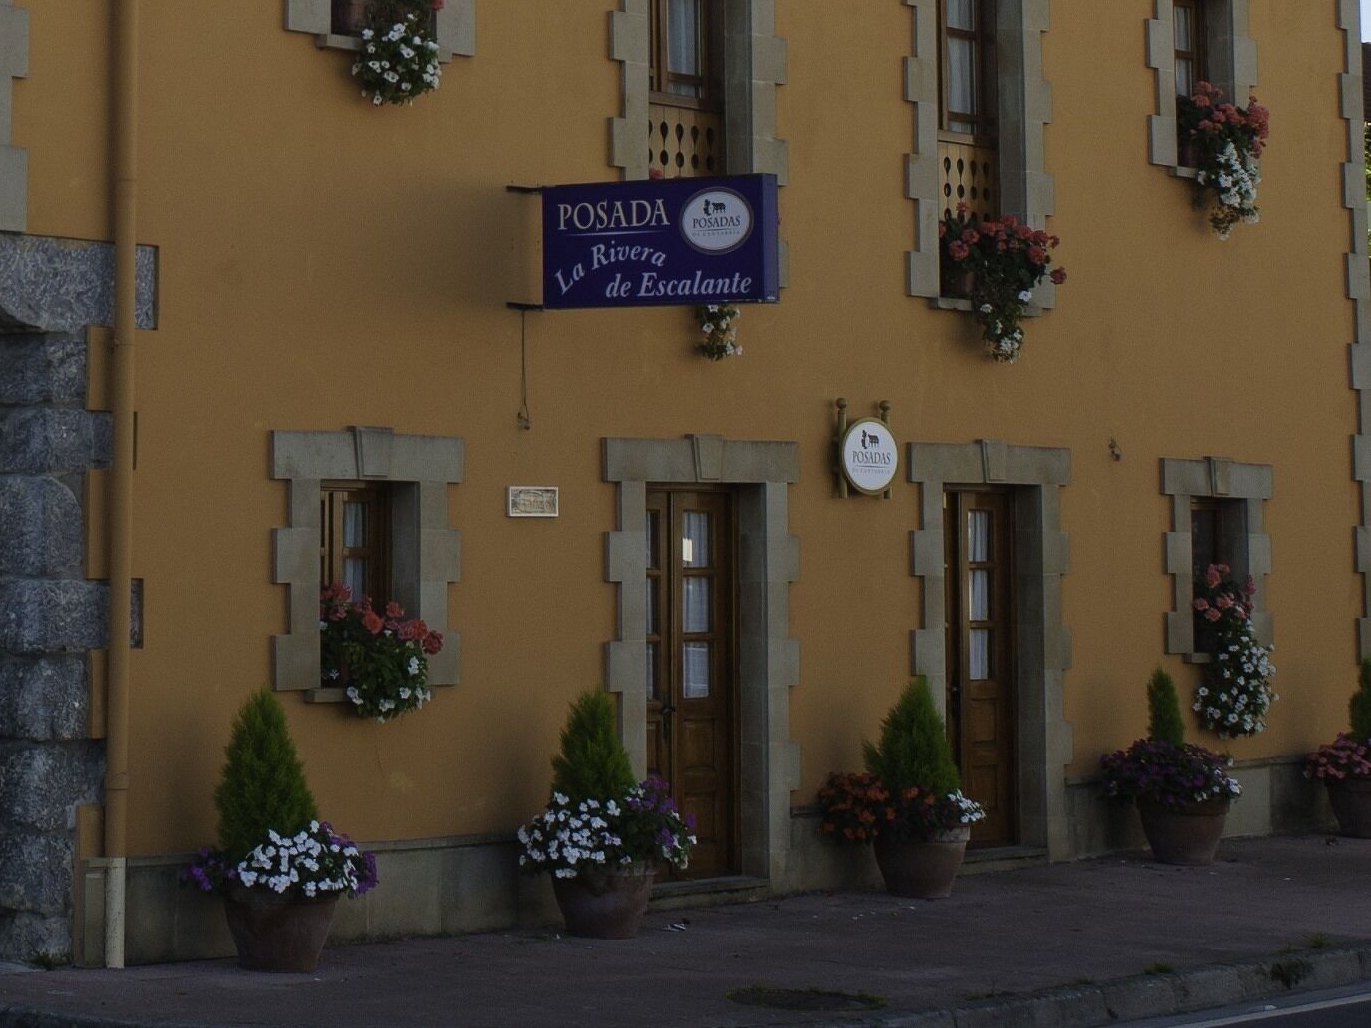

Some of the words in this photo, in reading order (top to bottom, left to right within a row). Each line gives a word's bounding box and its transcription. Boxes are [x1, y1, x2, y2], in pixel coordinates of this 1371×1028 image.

[557, 198, 671, 231] POSADA
[692, 215, 741, 230] POSADAS
[554, 262, 586, 296] La
[590, 240, 667, 270] Rivera
[605, 273, 631, 298] de
[636, 270, 752, 298] Escalante
[852, 450, 891, 465] POSADAS
